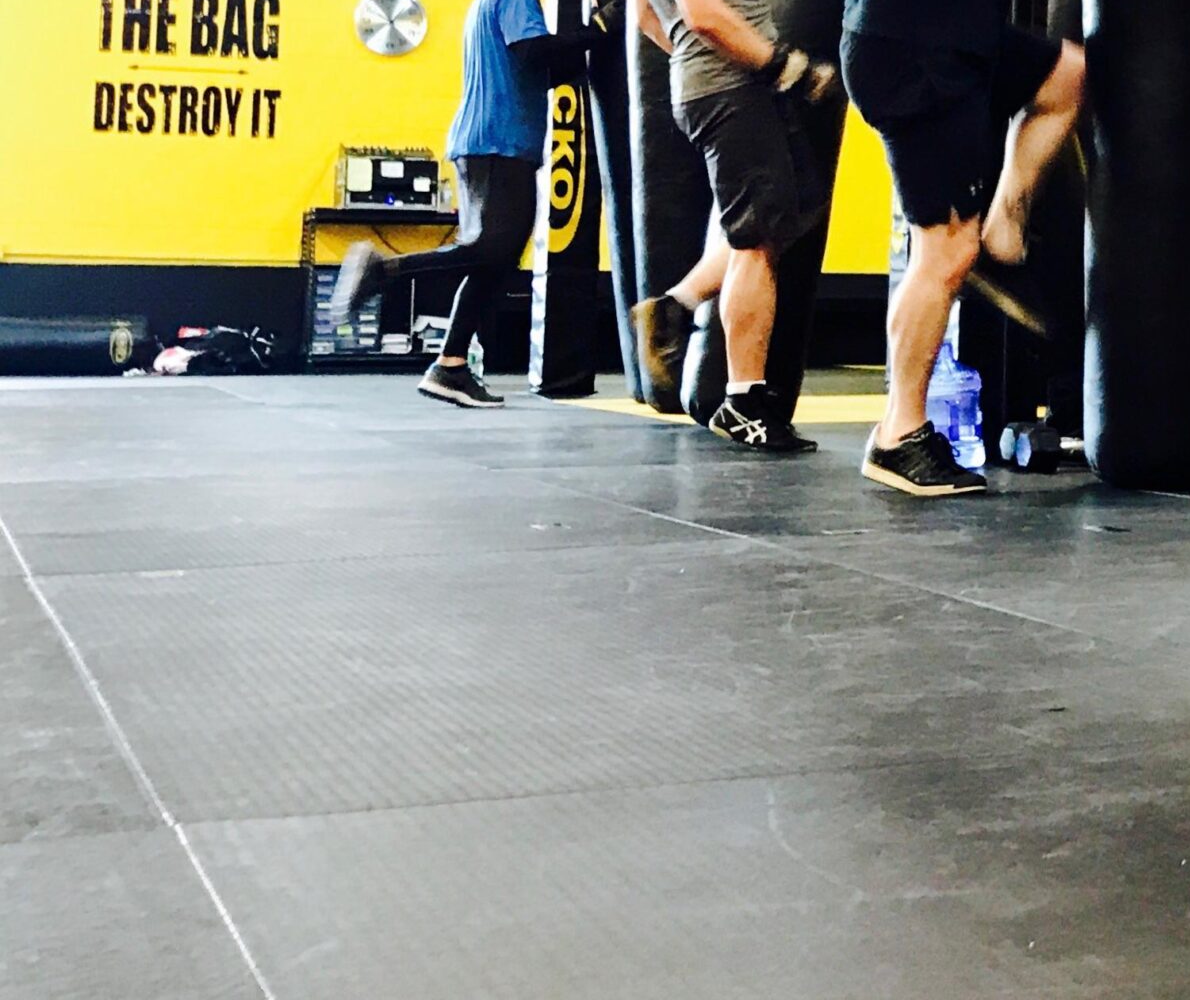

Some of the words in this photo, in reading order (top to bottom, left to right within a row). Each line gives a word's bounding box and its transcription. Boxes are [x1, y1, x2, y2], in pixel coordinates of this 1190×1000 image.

[93, 81, 244, 138] DESTROY
[251, 89, 282, 139] IT
[550, 84, 578, 210] CKO
